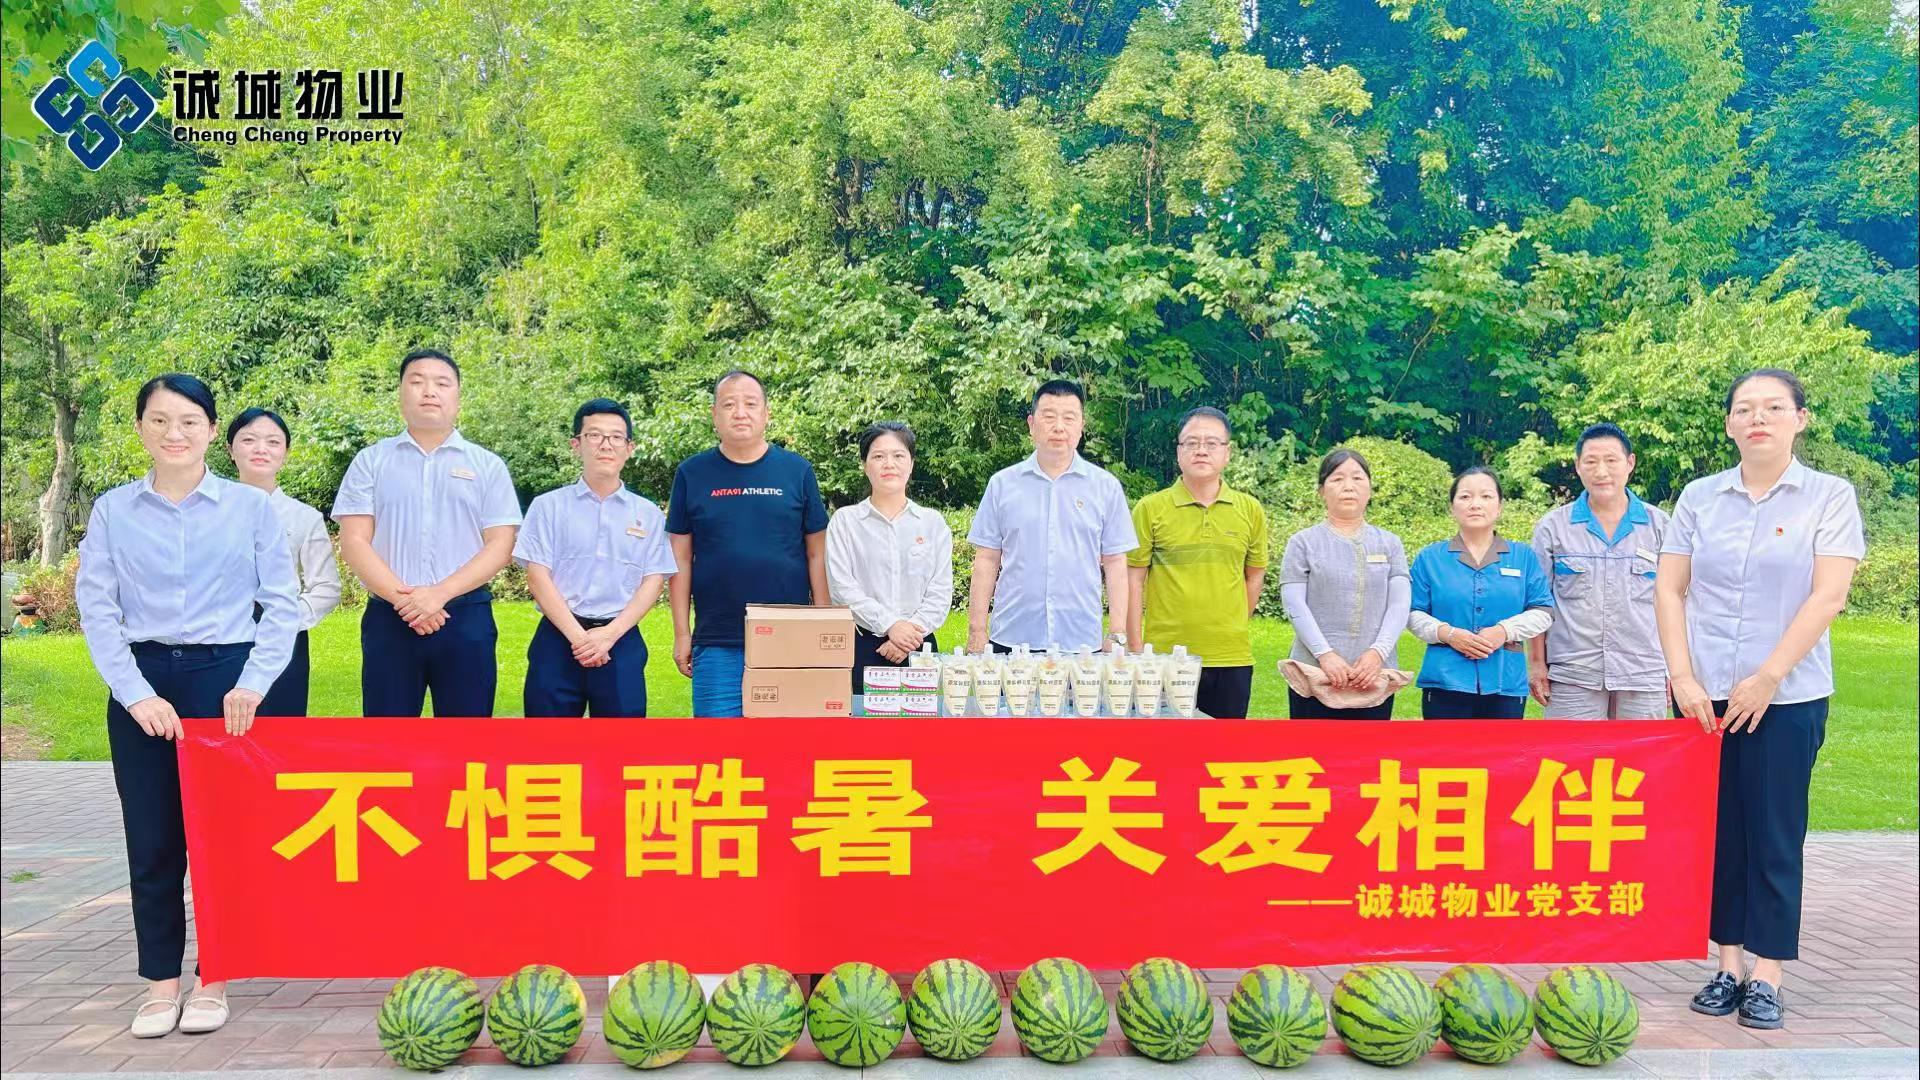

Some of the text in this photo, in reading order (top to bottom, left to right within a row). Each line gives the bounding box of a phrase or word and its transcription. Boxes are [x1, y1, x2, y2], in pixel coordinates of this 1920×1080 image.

[742, 487, 783, 496] ATHLETIC
[271, 756, 1647, 883] 不惧酷暑 关爱相伴
